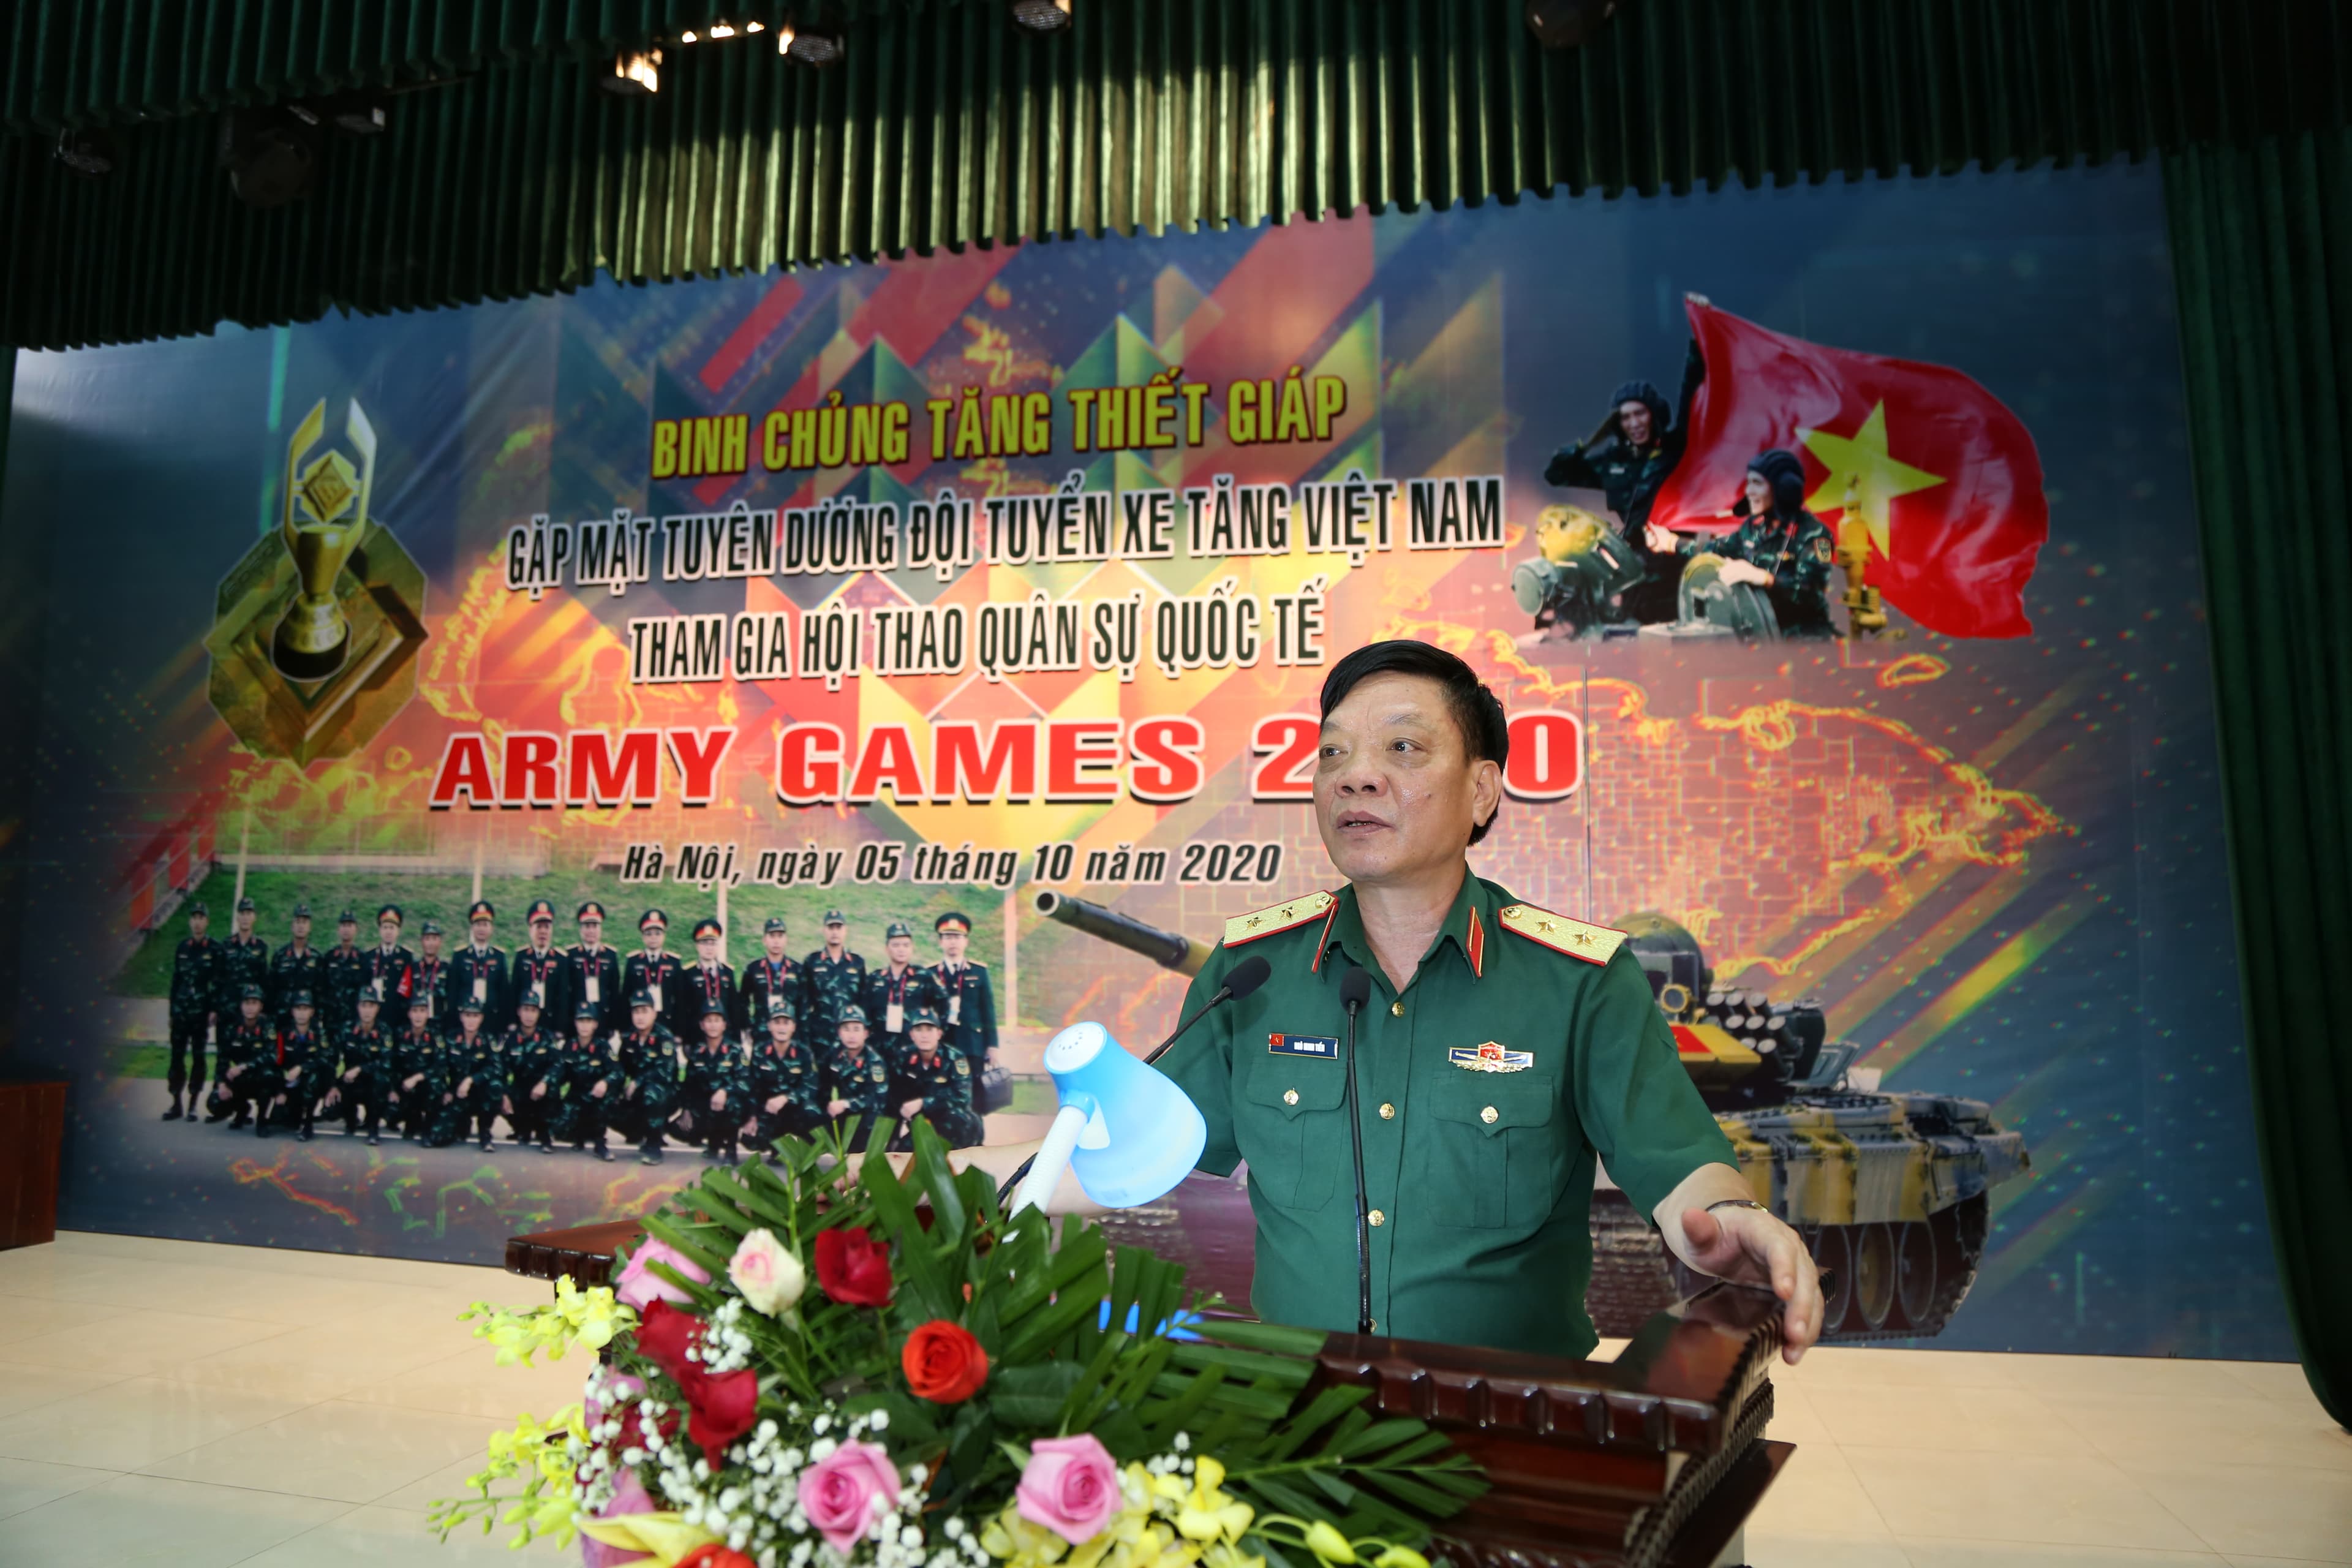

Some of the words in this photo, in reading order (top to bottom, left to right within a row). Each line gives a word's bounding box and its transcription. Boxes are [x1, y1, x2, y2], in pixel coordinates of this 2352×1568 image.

[651, 413, 748, 478] BINH
[763, 390, 910, 471] CHỦNG
[926, 386, 1052, 460] TĂNG
[1068, 367, 1209, 451] THIẾT
[1227, 366, 1346, 444] GIÁP
[508, 518, 570, 595] GẶP
[579, 513, 653, 592] MẶT
[665, 505, 774, 576] TUYÊN
[785, 500, 895, 568] DƯƠNG
[910, 491, 971, 575] ĐỘI
[986, 472, 1107, 558] TUYỂN
[1123, 492, 1173, 553] XE
[1187, 478, 1287, 551] TĂNG
[1303, 471, 1394, 560] VIỆT
[1409, 478, 1501, 545] NAM
[632, 619, 722, 678] THAM
[735, 616, 788, 674] GIA
[802, 601, 859, 686] HỘI
[875, 607, 963, 671] THAO
[979, 593, 1077, 676] QUÂN
[1093, 593, 1142, 675] SỰ
[1156, 580, 1256, 672] QUỐC
[1273, 577, 1323, 660] TẾ
[431, 728, 736, 805] ARMY
[778, 718, 1203, 803] GAMES
[1253, 710, 1584, 799] 20
[623, 844, 663, 880] Hà
[677, 844, 742, 889] Nội,
[756, 844, 843, 885] ngày
[854, 844, 904, 881] 05
[913, 843, 1018, 886] tháng
[1034, 844, 1074, 881] 10
[1084, 845, 1167, 881] năm
[1179, 844, 1283, 882] 2020
